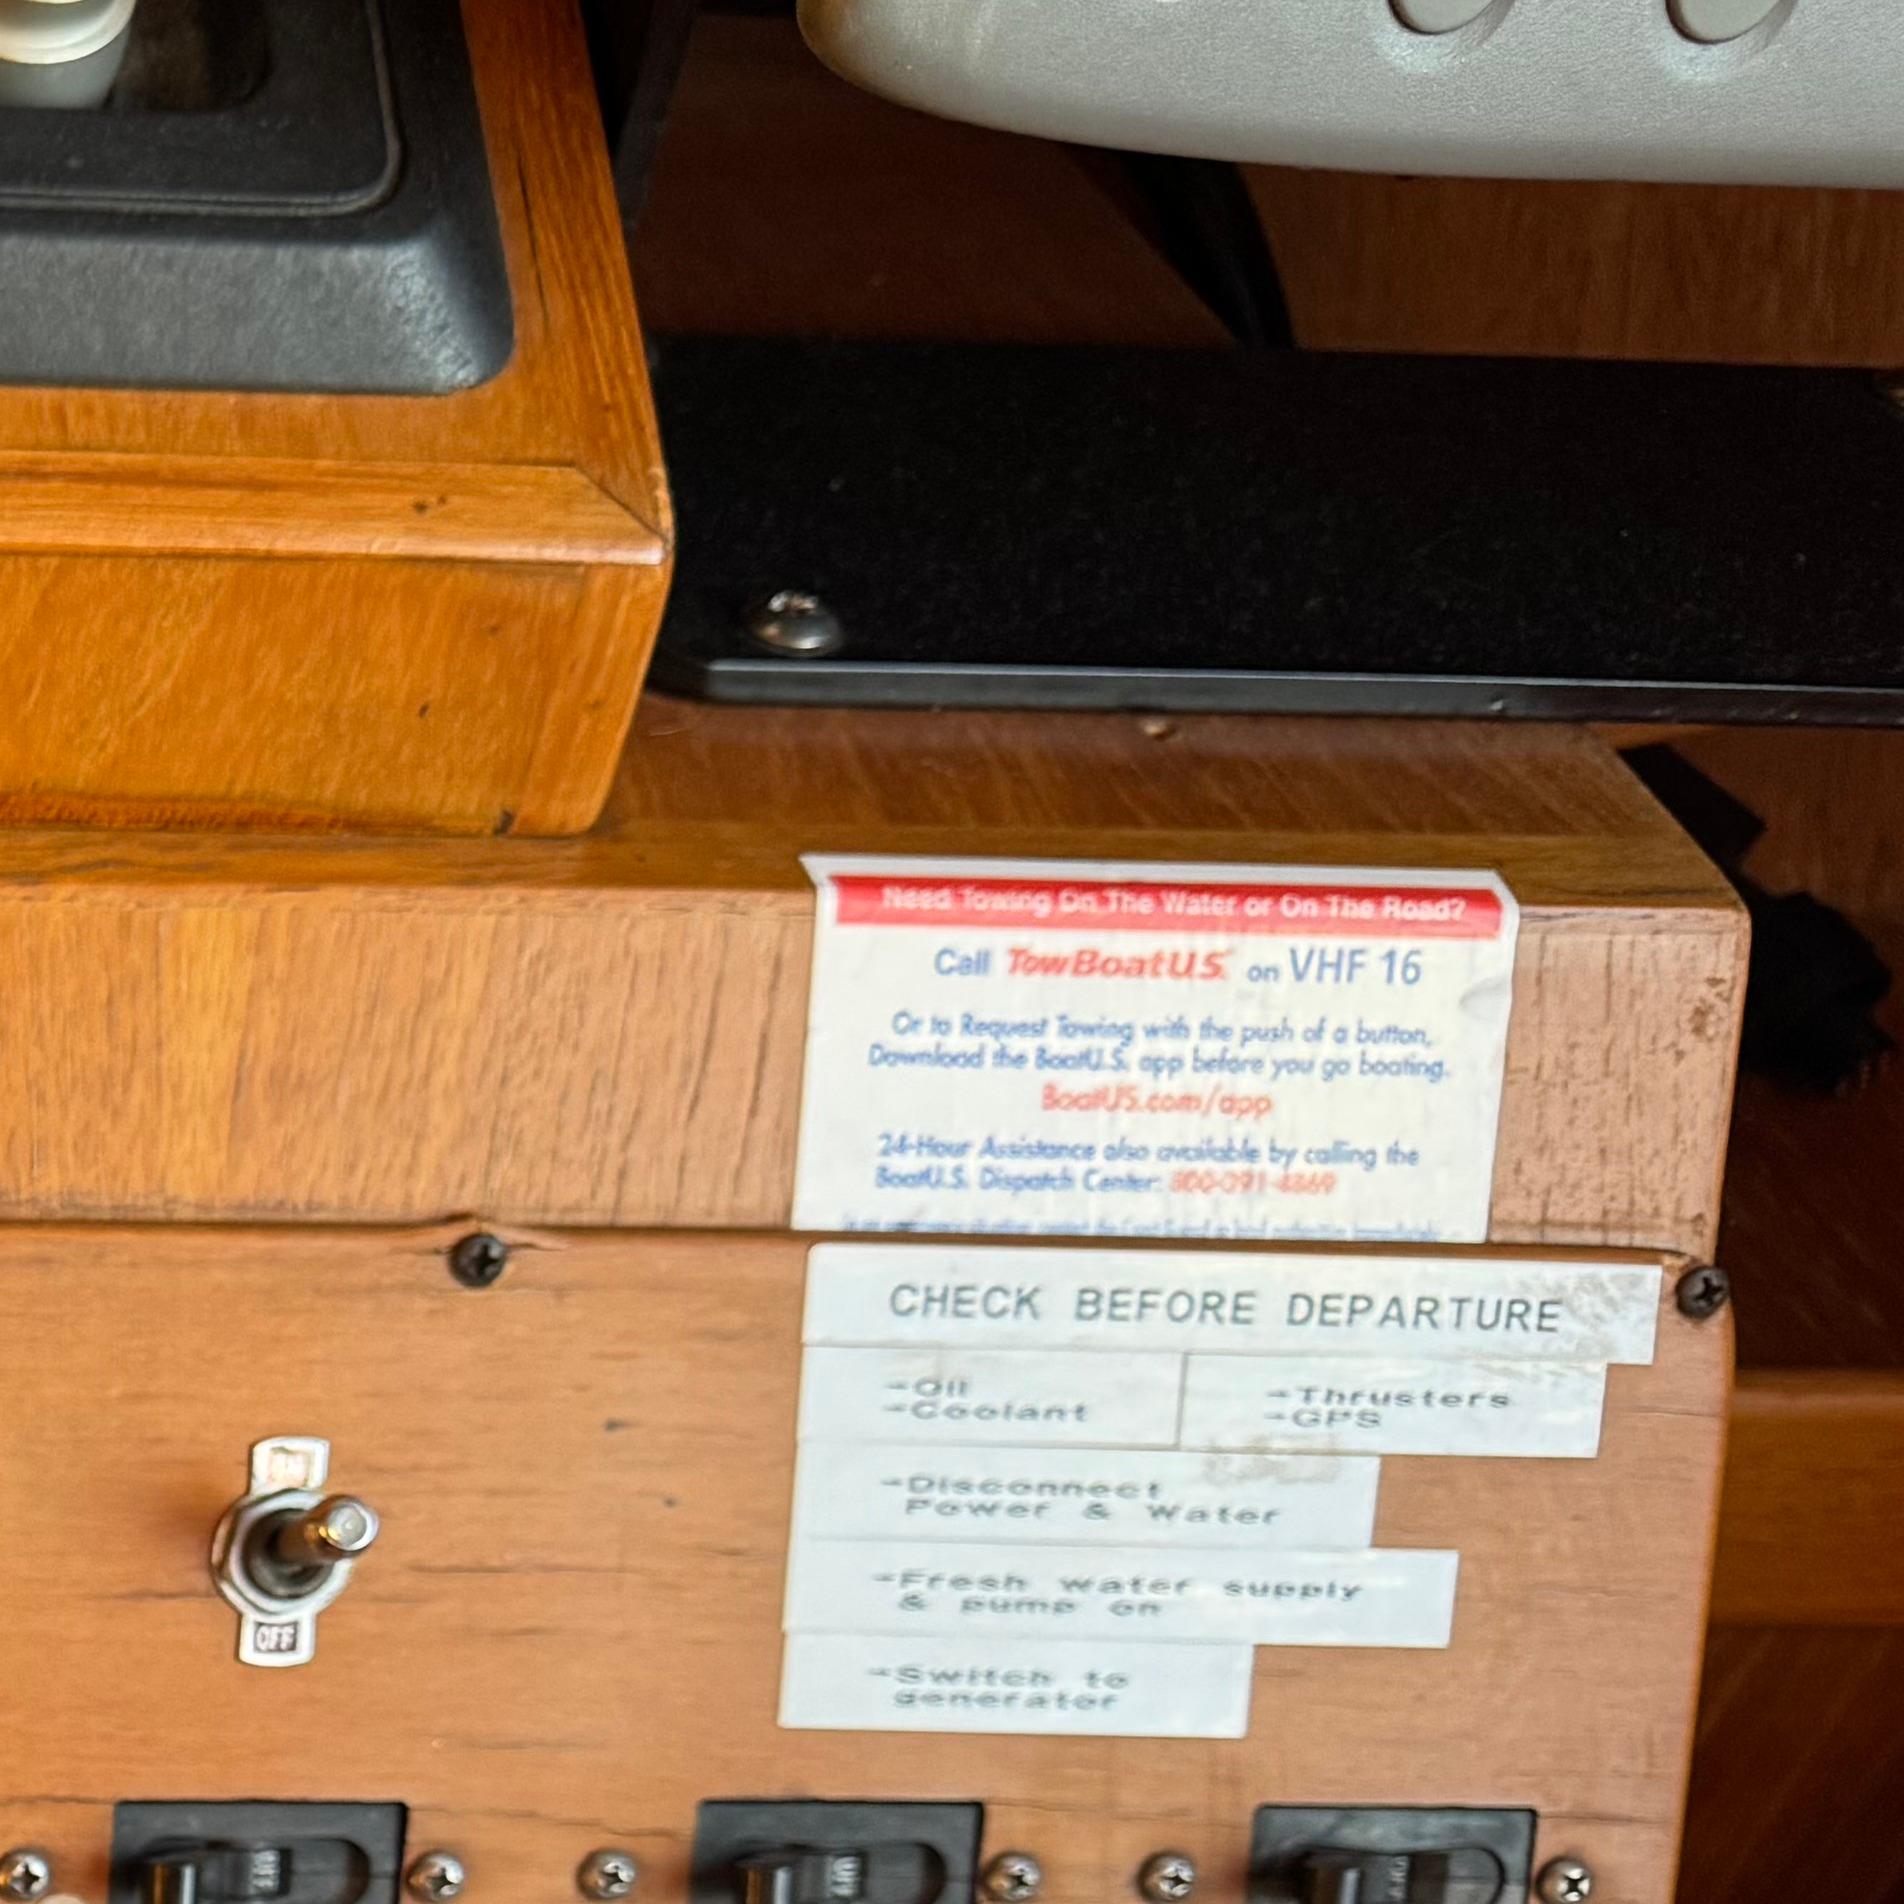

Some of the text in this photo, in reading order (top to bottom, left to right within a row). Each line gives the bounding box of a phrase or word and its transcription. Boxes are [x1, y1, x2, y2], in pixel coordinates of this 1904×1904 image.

[883, 887, 1466, 922] Need Towing On The Water or On The Road?
[934, 948, 990, 976] Call
[1247, 962, 1278, 983] on
[1290, 948, 1366, 984] VHF
[1381, 949, 1422, 986] 16
[961, 1015, 1048, 1043] Request
[1058, 1016, 1134, 1044] Towing
[1144, 1017, 1190, 1040] with
[1200, 1017, 1231, 1041] the
[1241, 1018, 1293, 1049] push
[1302, 1021, 1325, 1044] of
[869, 1043, 983, 1068] Download
[993, 1045, 1026, 1068] the
[1139, 1053, 1182, 1079] app
[1192, 1048, 1264, 1075] before
[1272, 1056, 1314, 1082] you
[1323, 1058, 1349, 1082] go
[888, 1285, 1566, 1334] CHECK BEFORE DEPARTURE
[906, 1497, 1282, 1526] Power & Water
[1060, 1574, 1190, 1596] water
[1223, 1578, 1363, 1602] supply
[962, 1598, 1078, 1619] pump
[1110, 1599, 1162, 1617] on
[256, 1627, 295, 1650] OFF
[1085, 1669, 1129, 1689] to
[893, 1690, 1120, 1712] generator
